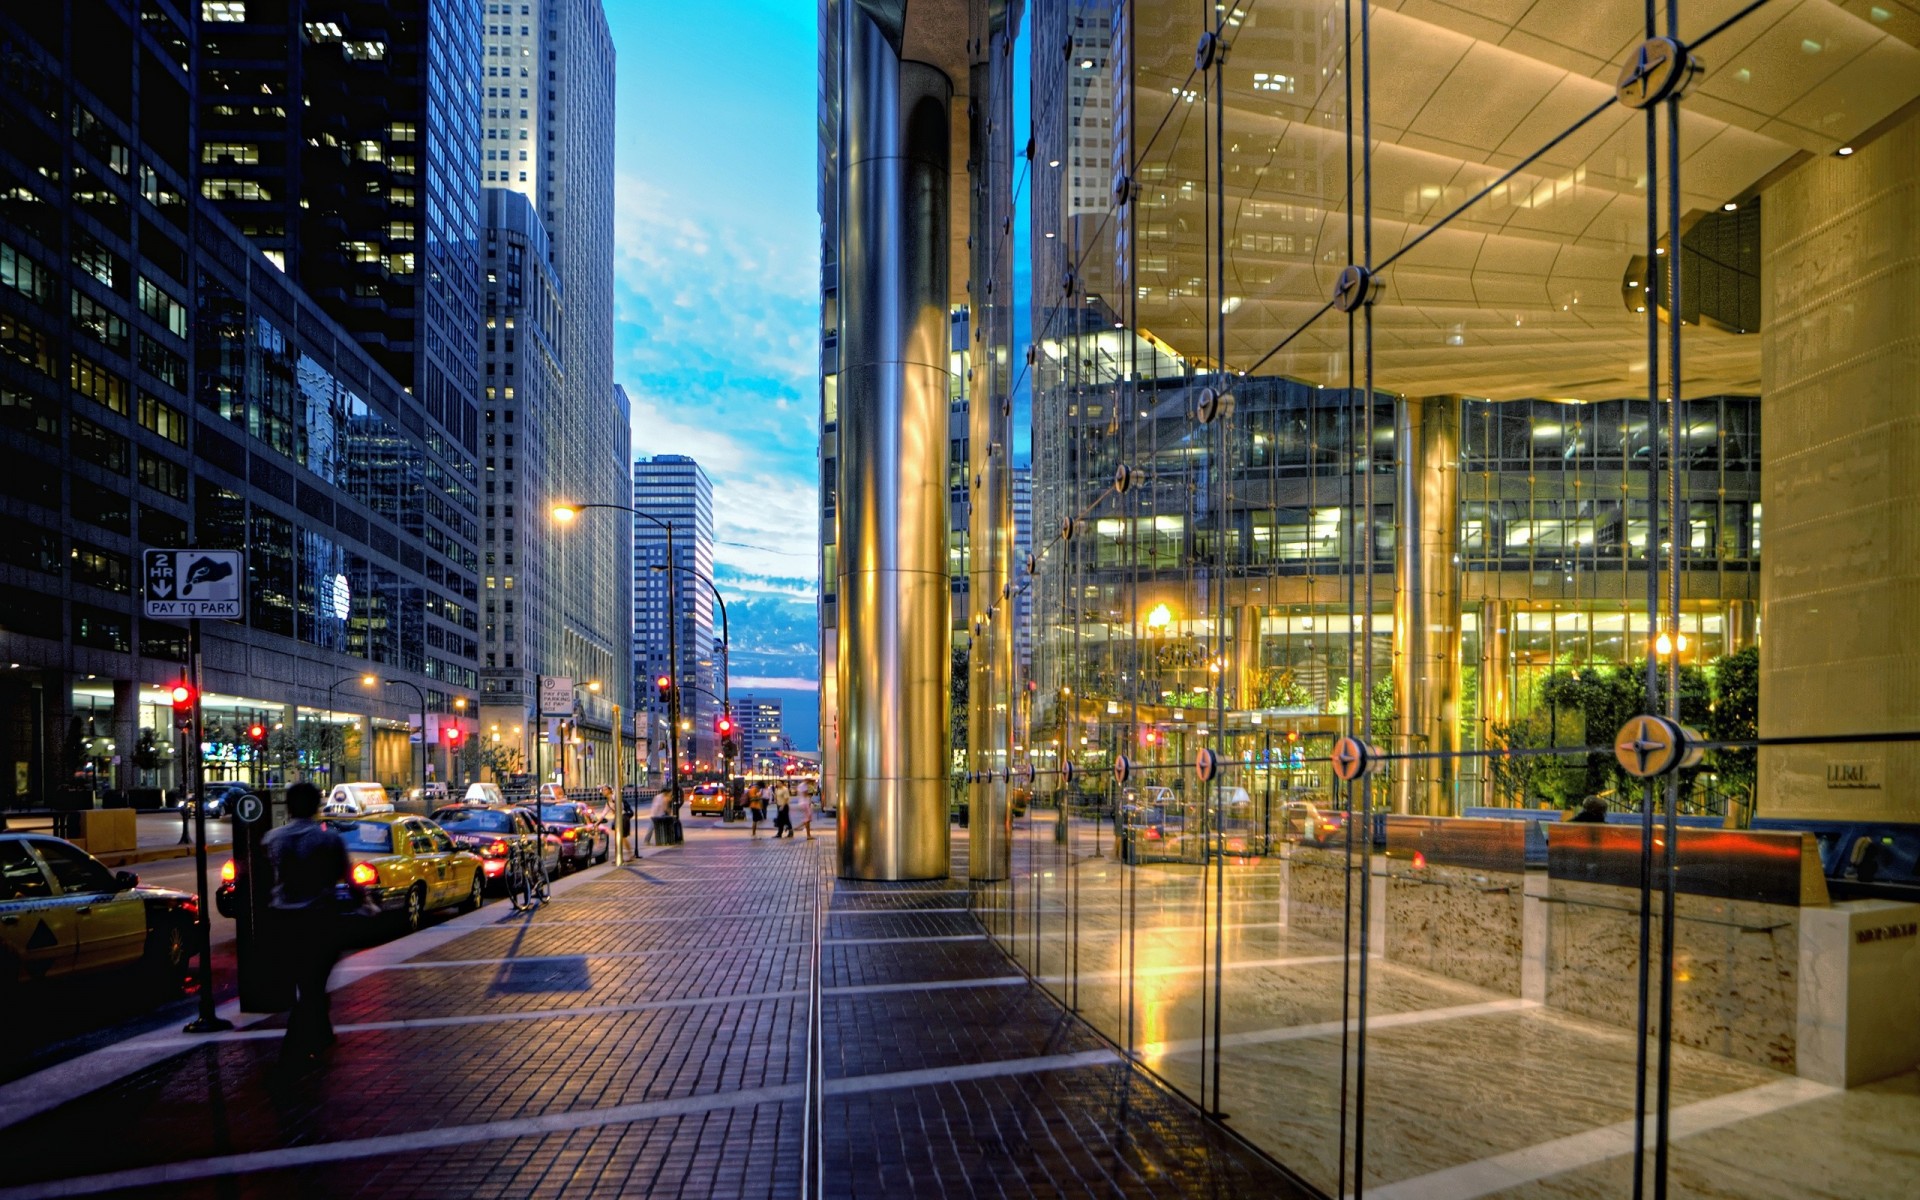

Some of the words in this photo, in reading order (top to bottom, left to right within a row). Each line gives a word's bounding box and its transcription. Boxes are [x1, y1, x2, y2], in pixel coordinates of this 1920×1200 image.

[155, 554, 169, 567] 2
[150, 567, 174, 578] HR
[152, 602, 176, 613] PAY
[181, 602, 196, 613] TO
[201, 602, 235, 613] PARK
